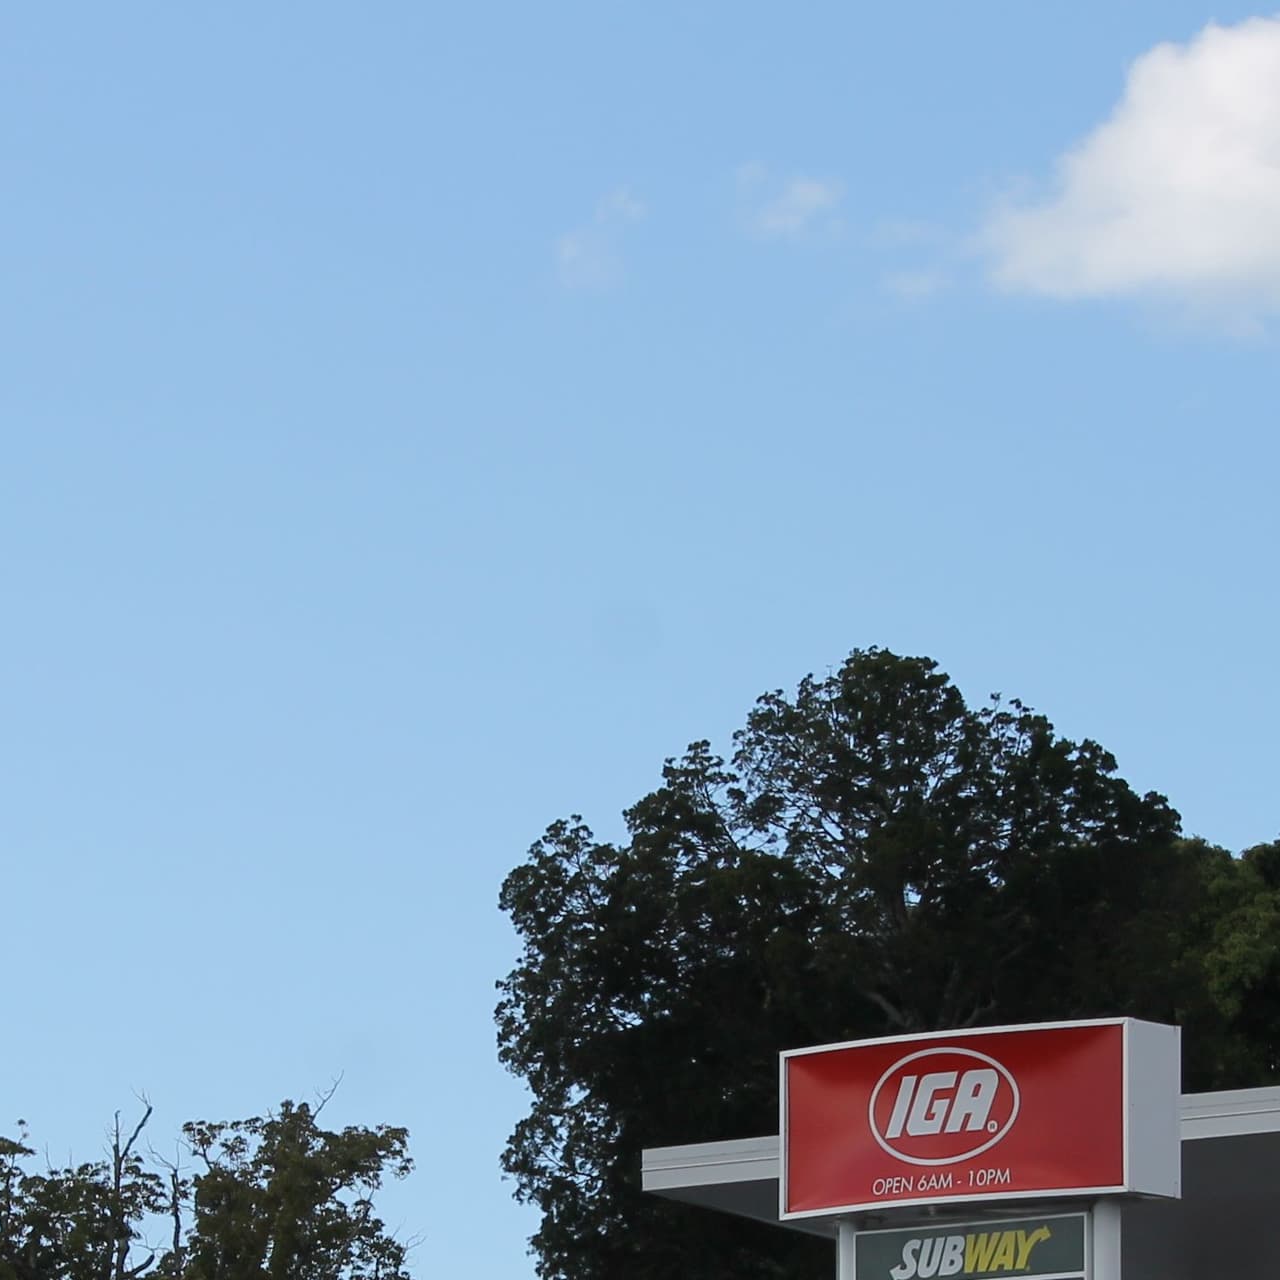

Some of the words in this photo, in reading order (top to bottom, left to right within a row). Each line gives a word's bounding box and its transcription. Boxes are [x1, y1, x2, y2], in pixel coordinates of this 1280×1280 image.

[885, 1068, 998, 1139] IGA
[872, 1175, 914, 1195] OPEN
[917, 1173, 953, 1192] 6AM
[968, 1168, 1011, 1188] 10PM
